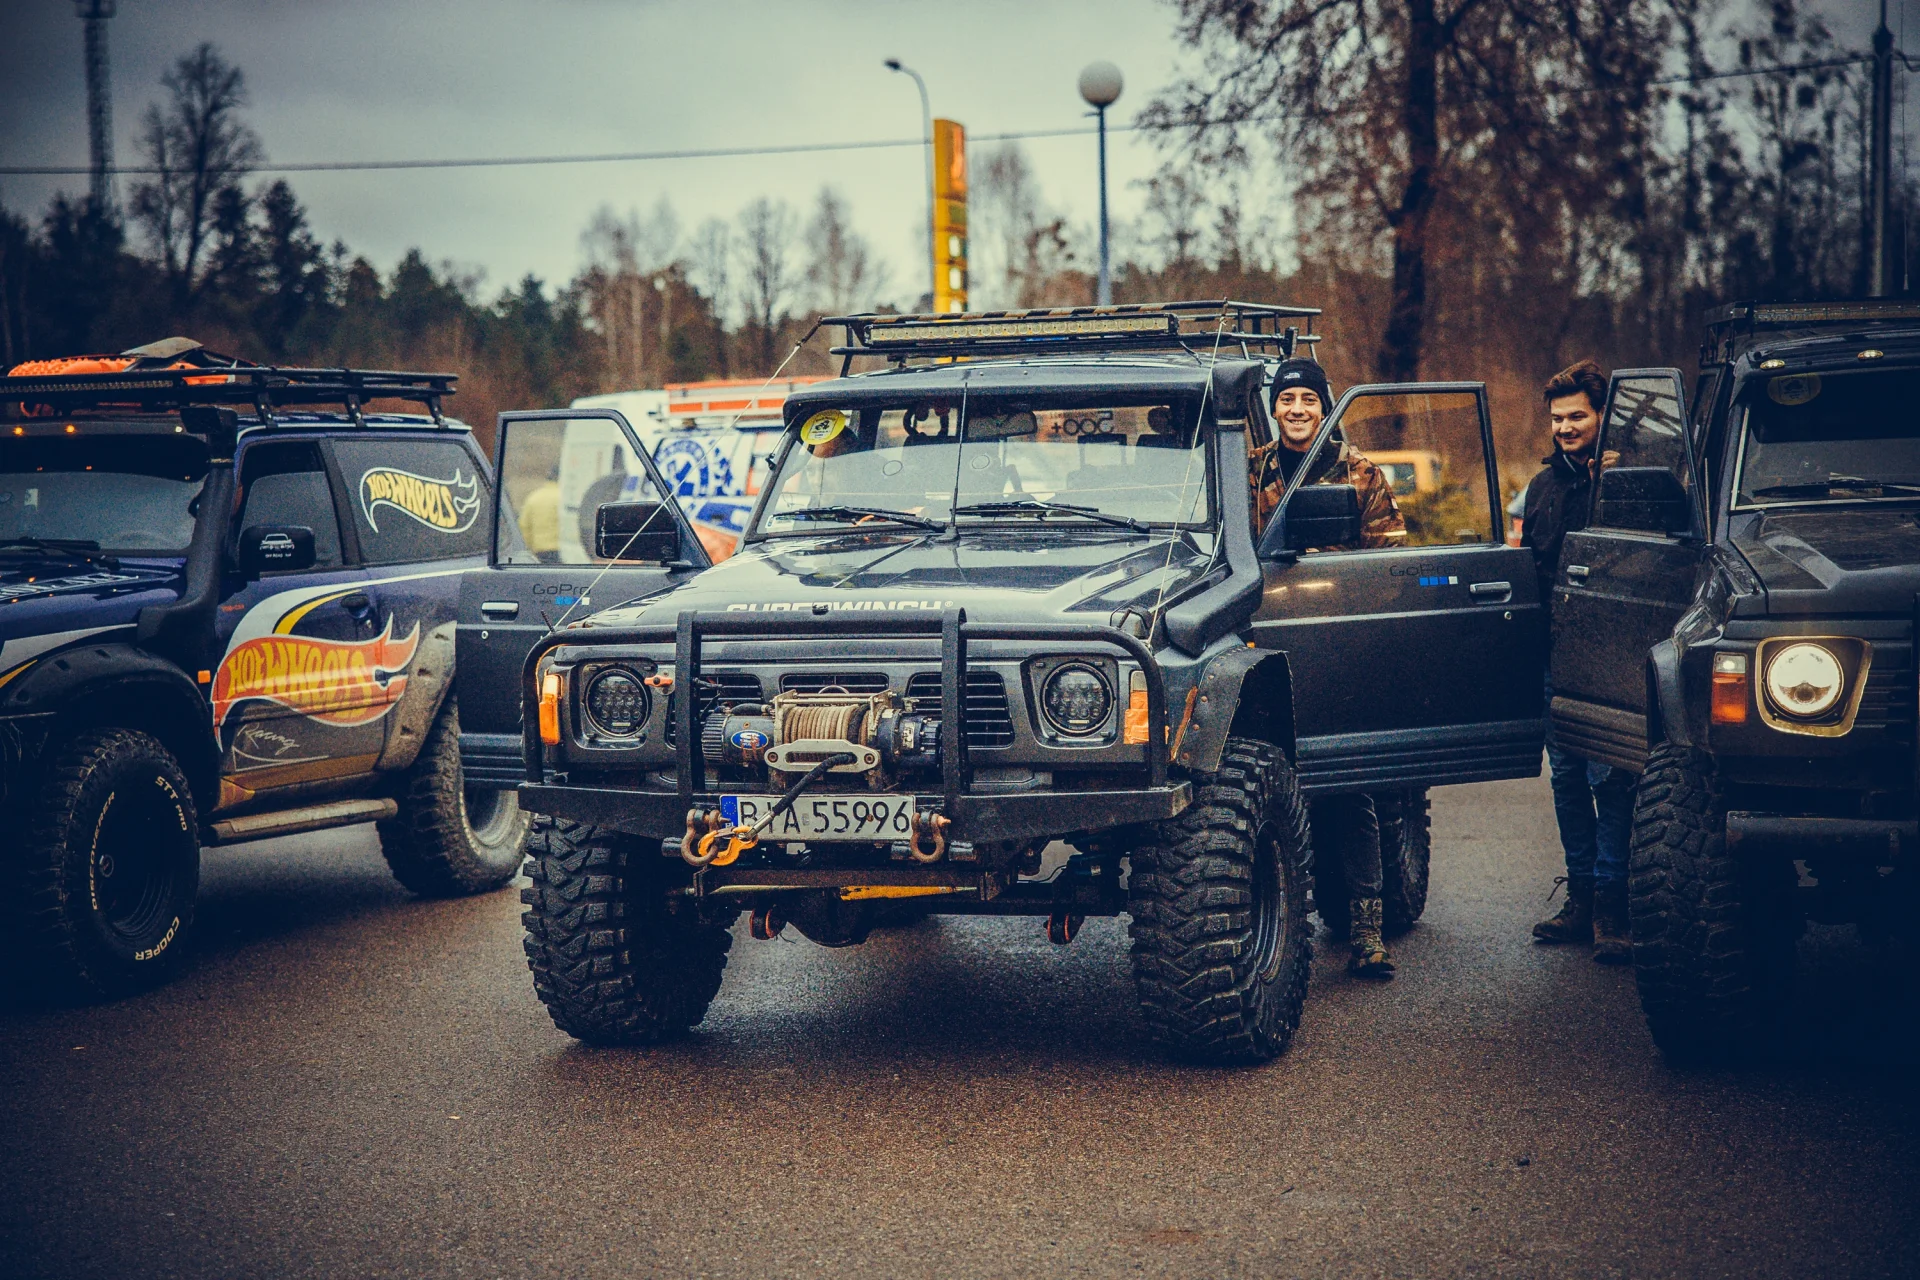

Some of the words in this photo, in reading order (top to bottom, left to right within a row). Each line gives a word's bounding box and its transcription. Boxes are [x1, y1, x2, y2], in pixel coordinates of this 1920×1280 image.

[1390, 563, 1456, 576] GoPro
[532, 583, 591, 595] GoPro
[155, 775, 179, 800] STT
[175, 804, 188, 831] PRO
[812, 801, 911, 834] 55996
[135, 916, 180, 960] COOPER
